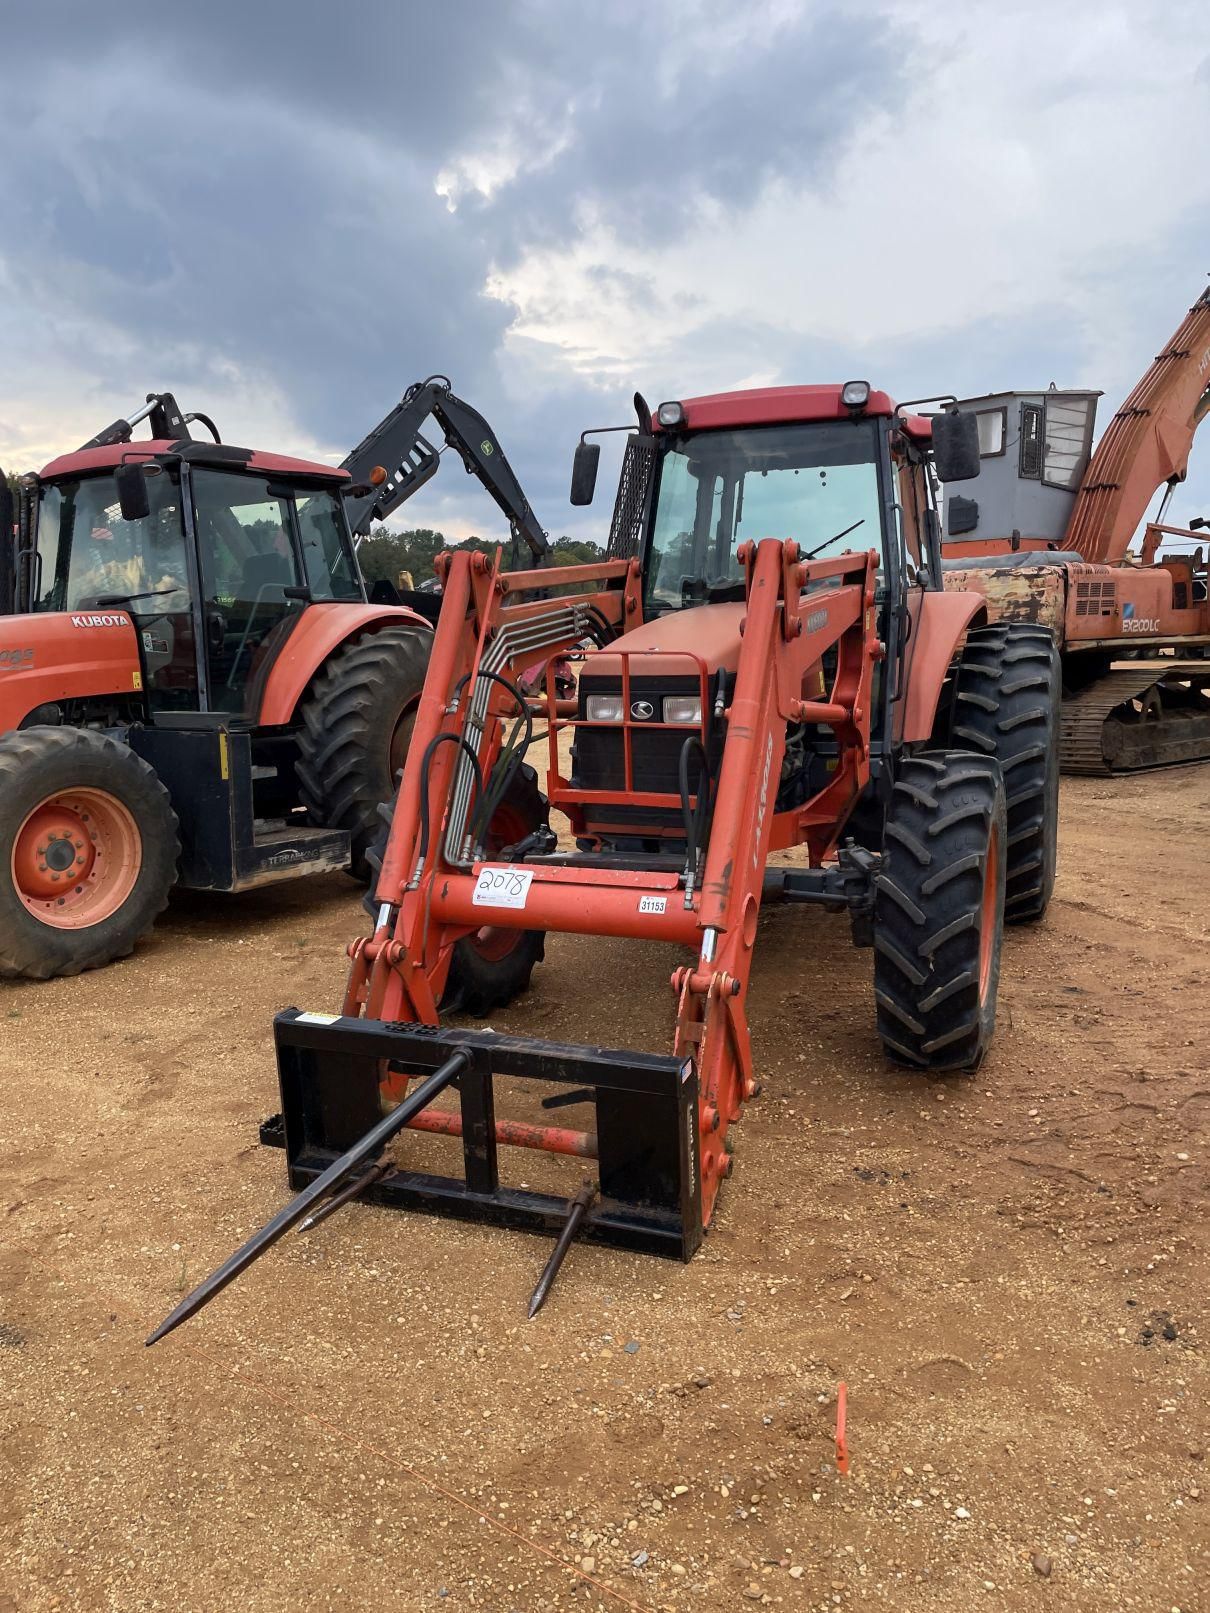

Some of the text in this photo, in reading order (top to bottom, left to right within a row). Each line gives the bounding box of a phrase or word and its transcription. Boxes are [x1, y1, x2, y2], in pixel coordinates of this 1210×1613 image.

[71, 615, 129, 628] KUBOTA
[1122, 619, 1160, 632] EX200LC
[480, 870, 528, 895] 2078
[641, 900, 665, 912] 31153
